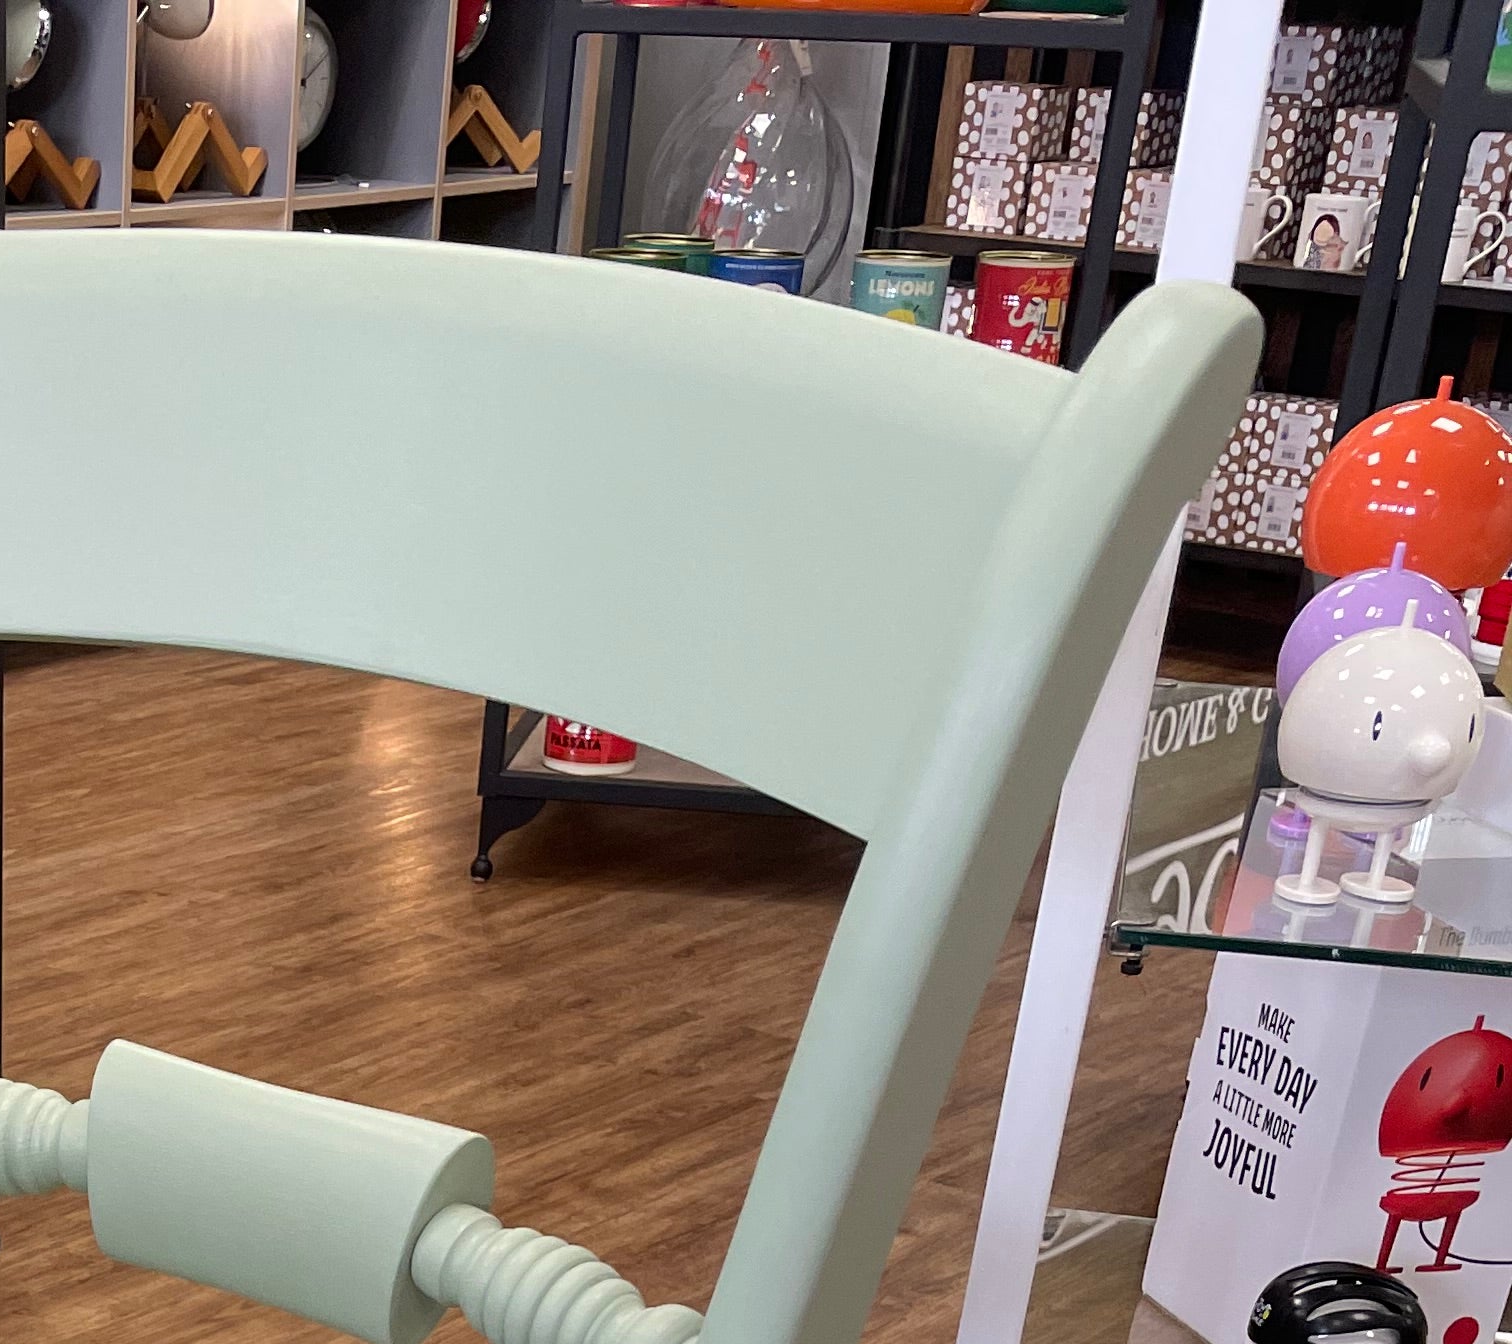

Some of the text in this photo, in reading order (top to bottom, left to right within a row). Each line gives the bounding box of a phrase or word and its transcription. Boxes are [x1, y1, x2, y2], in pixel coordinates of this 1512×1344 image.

[550, 731, 602, 751] PASSATA
[1257, 1002, 1295, 1044] MAKE
[1216, 1026, 1318, 1114] EVERY DAY
[1212, 1079, 1297, 1149] A LITTLE MORE
[1202, 1118, 1277, 1200] JOYFUL
